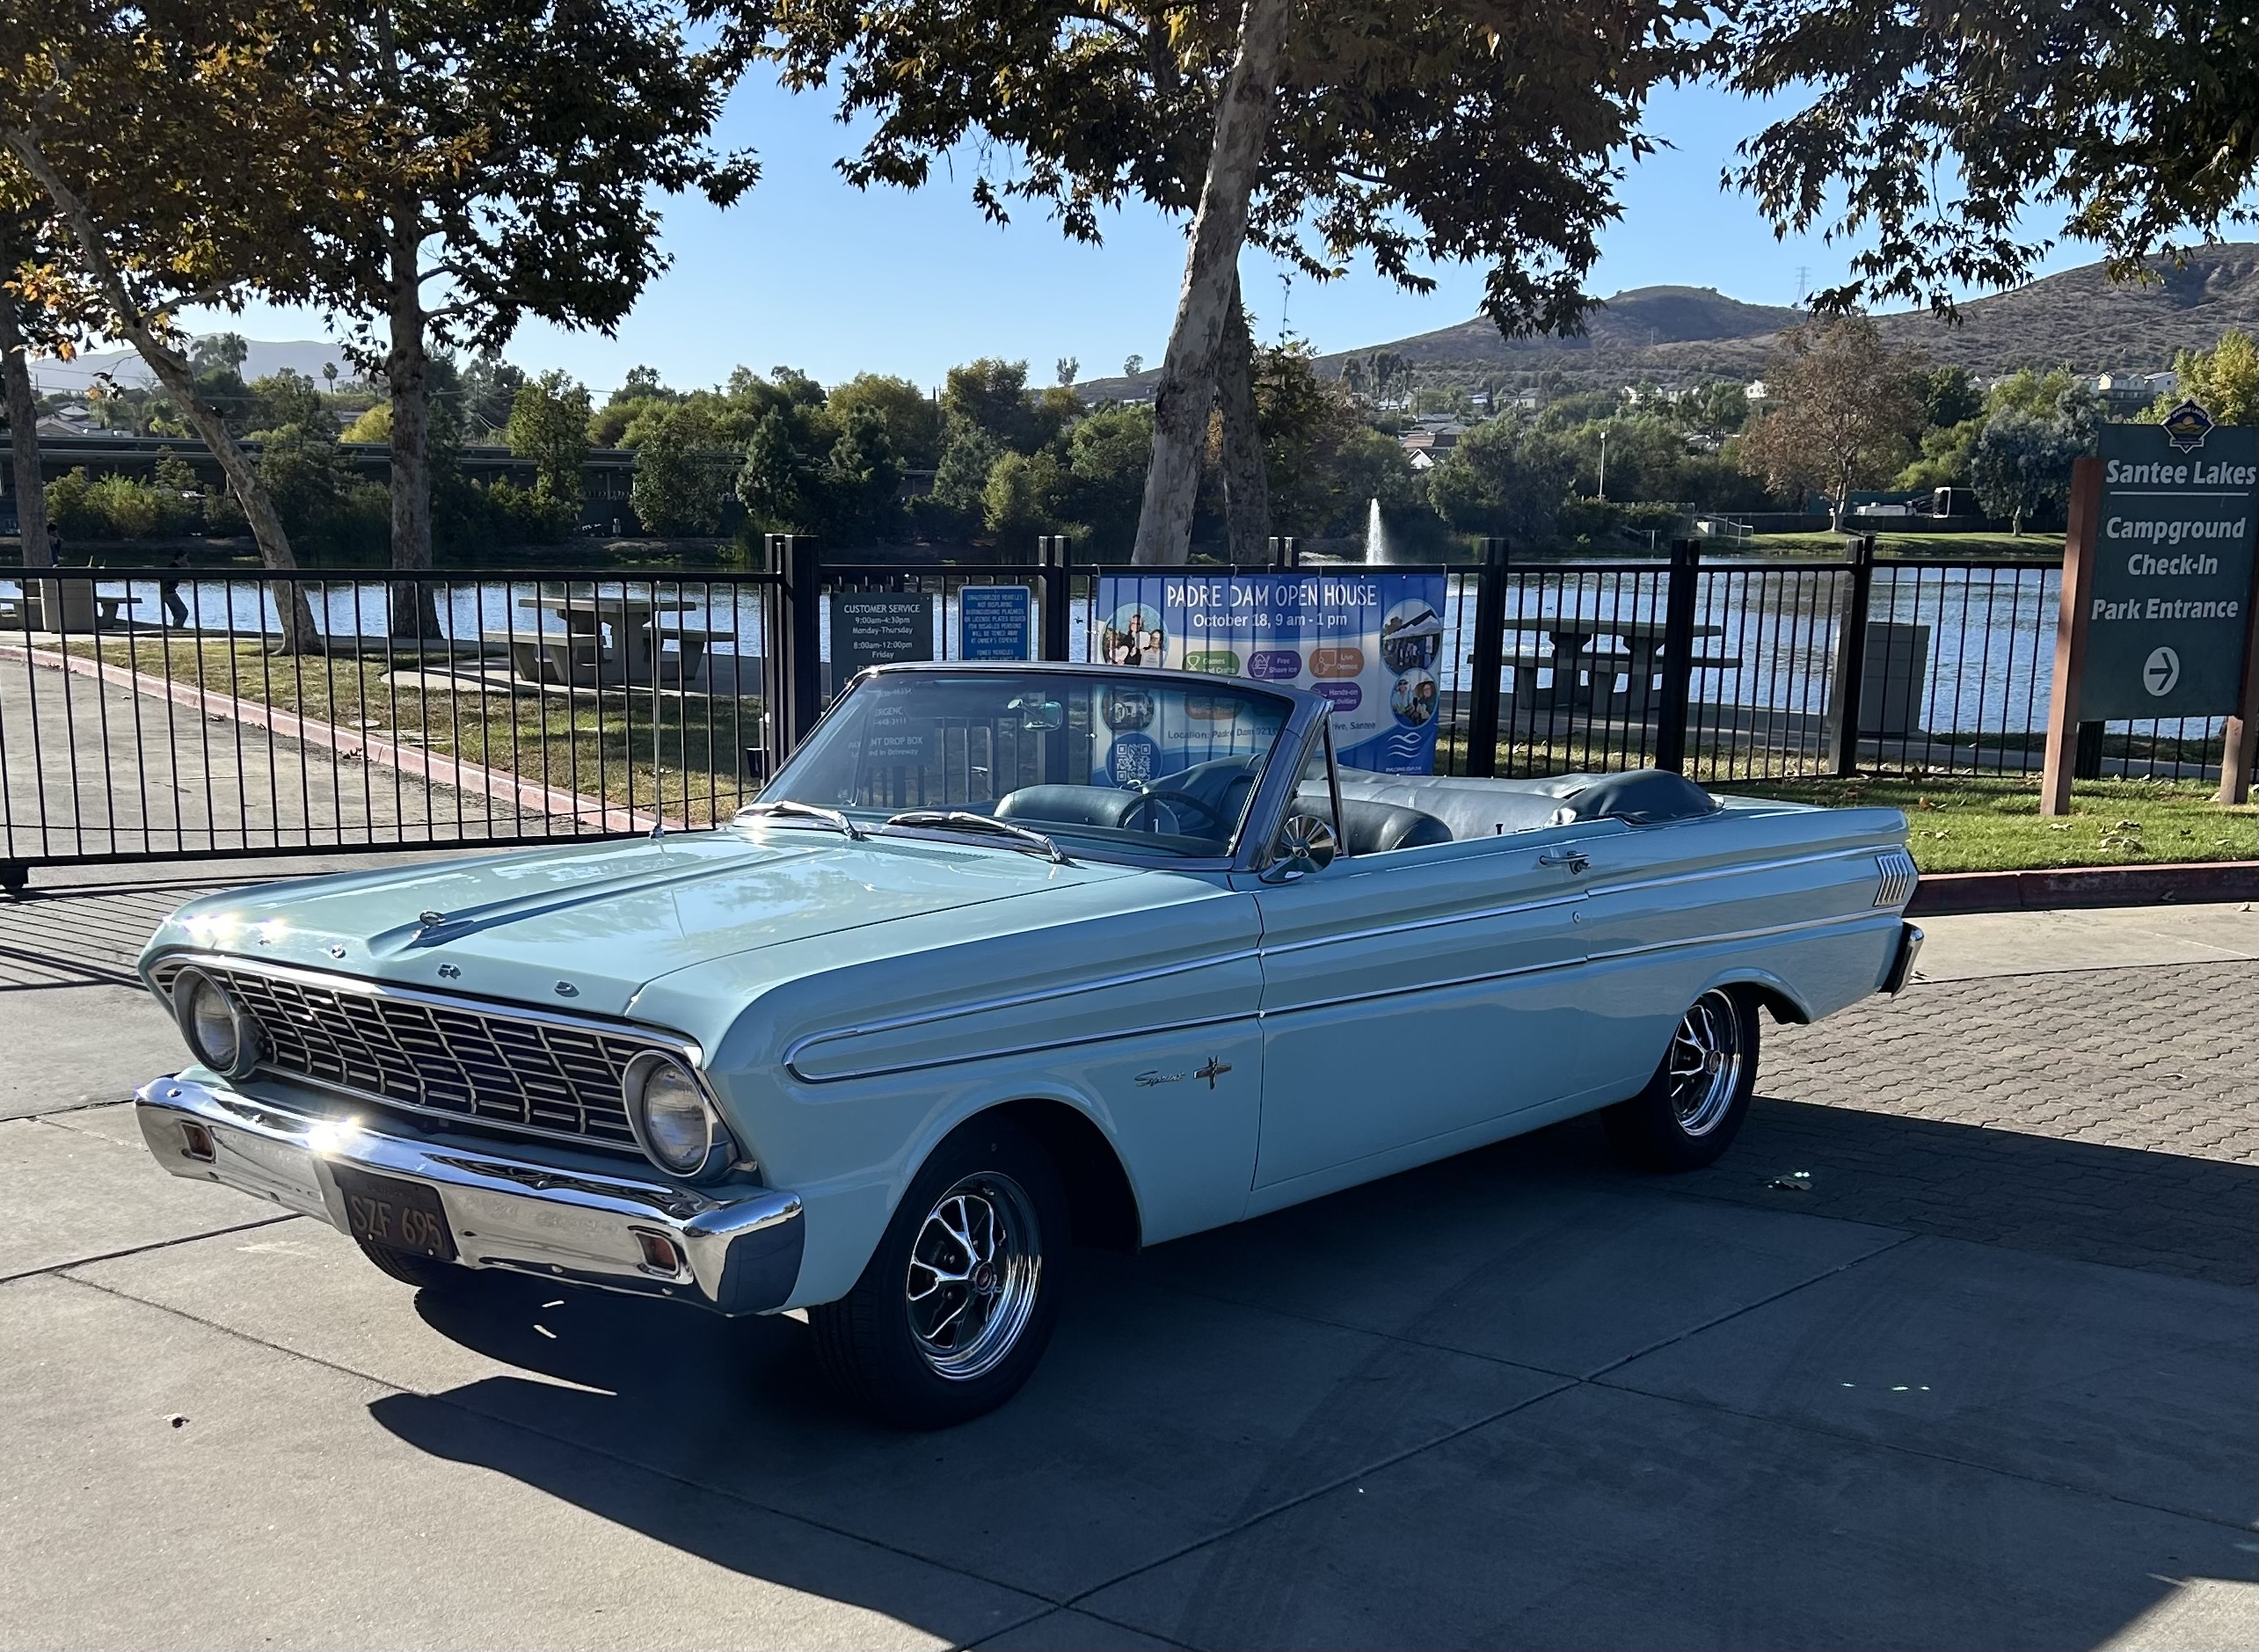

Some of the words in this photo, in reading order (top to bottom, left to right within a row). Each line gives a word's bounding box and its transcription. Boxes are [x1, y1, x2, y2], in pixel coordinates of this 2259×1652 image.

[2105, 459, 2188, 484] Santee
[2193, 462, 2256, 484] Lakes
[2106, 516, 2246, 544] Campground
[2127, 554, 2219, 576] Check-In
[1167, 585, 1223, 608] PADRE
[1230, 584, 1270, 608] DAM
[1274, 584, 1319, 608] OPEN
[1323, 584, 1378, 607] HOUSE
[843, 604, 887, 614] CUSTOMER
[888, 604, 921, 613] SERVICE
[1193, 613, 1249, 628] October
[1252, 613, 1272, 629] 18,
[1275, 615, 1284, 627] 9
[1286, 616, 1306, 627] am
[1327, 615, 1348, 629] pm
[2091, 599, 2141, 621] Park
[2145, 597, 2240, 620] Entrance
[871, 651, 895, 659] Friday
[352, 1195, 392, 1239] SZF
[402, 1207, 444, 1250] 695
